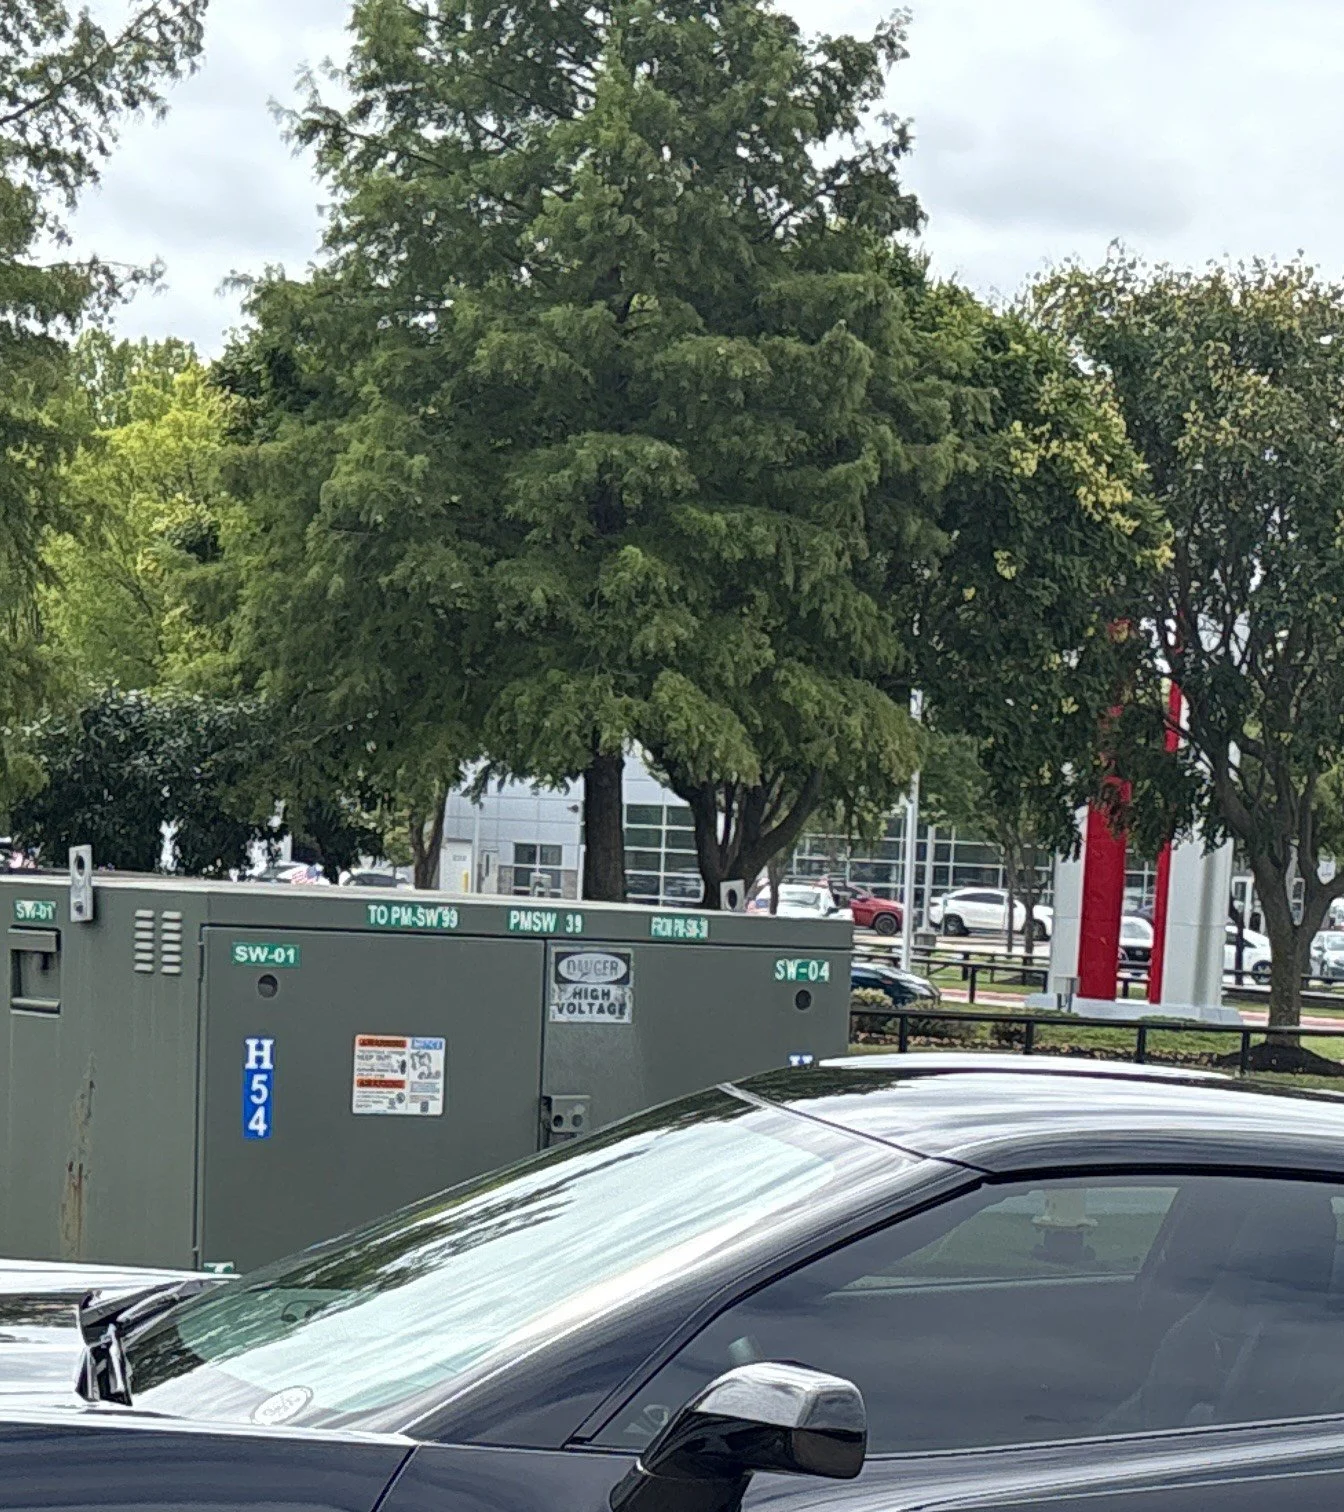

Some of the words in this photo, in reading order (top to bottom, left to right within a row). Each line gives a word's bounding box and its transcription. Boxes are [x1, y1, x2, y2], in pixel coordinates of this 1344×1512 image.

[367, 904, 388, 925] TO
[509, 910, 557, 933] PMSW
[234, 945, 296, 964] SW-01
[775, 959, 830, 981] SW-04
[572, 987, 611, 1000] HIGH
[556, 1002, 627, 1016] VOLTAGE
